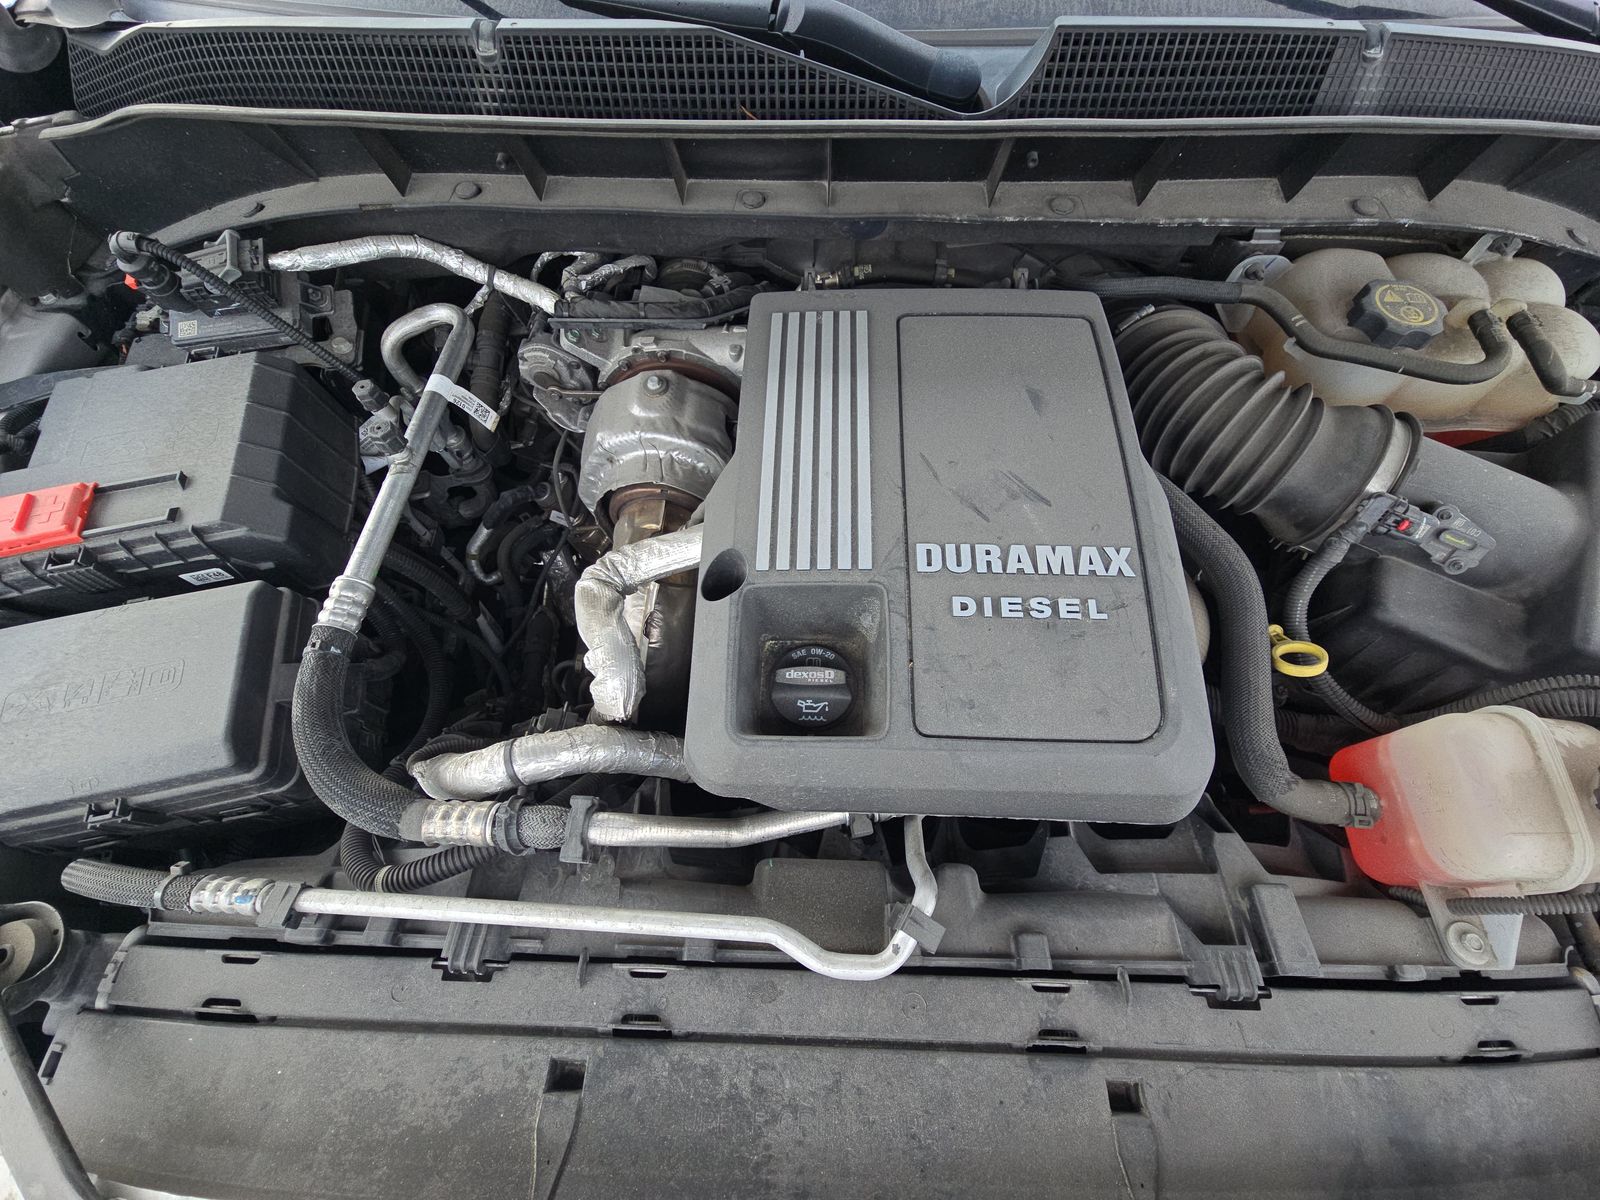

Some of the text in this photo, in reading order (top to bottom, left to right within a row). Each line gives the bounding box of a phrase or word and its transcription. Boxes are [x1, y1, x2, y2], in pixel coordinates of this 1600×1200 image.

[915, 542, 1136, 577] DURAMAX
[951, 596, 1108, 620] DIESEL
[791, 648, 836, 660] SAE 0W-20
